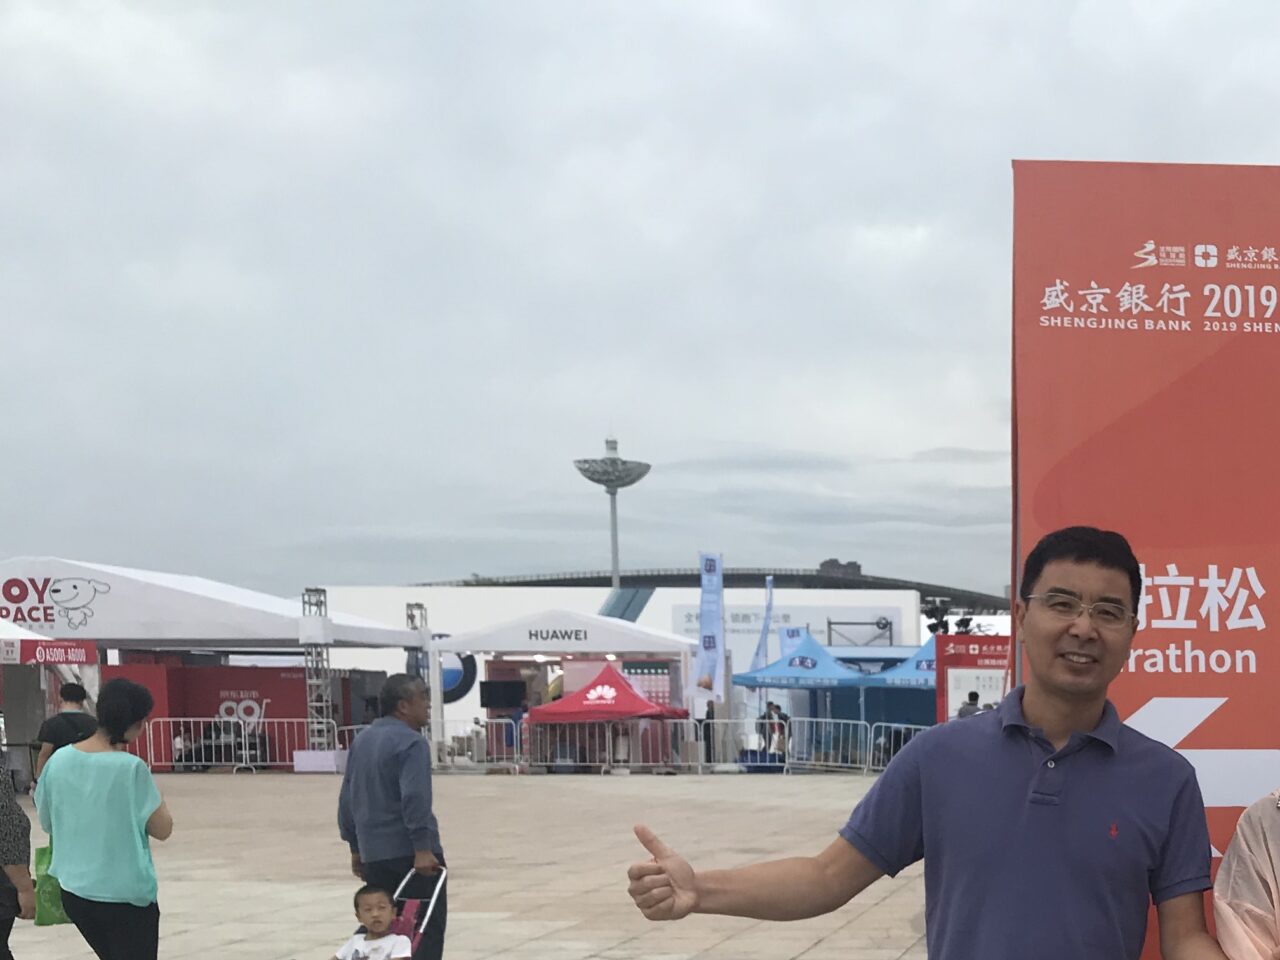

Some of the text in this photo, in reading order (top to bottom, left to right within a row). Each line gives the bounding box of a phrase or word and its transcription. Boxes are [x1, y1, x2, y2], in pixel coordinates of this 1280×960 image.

[1040, 279, 1192, 316] 盛京銀行
[1039, 316, 1192, 331] SHENGJING BANK
[1203, 321, 1237, 331] 2019
[2, 577, 51, 604] OY
[529, 629, 588, 641] HUAWEI
[1120, 640, 1257, 673] rathon
